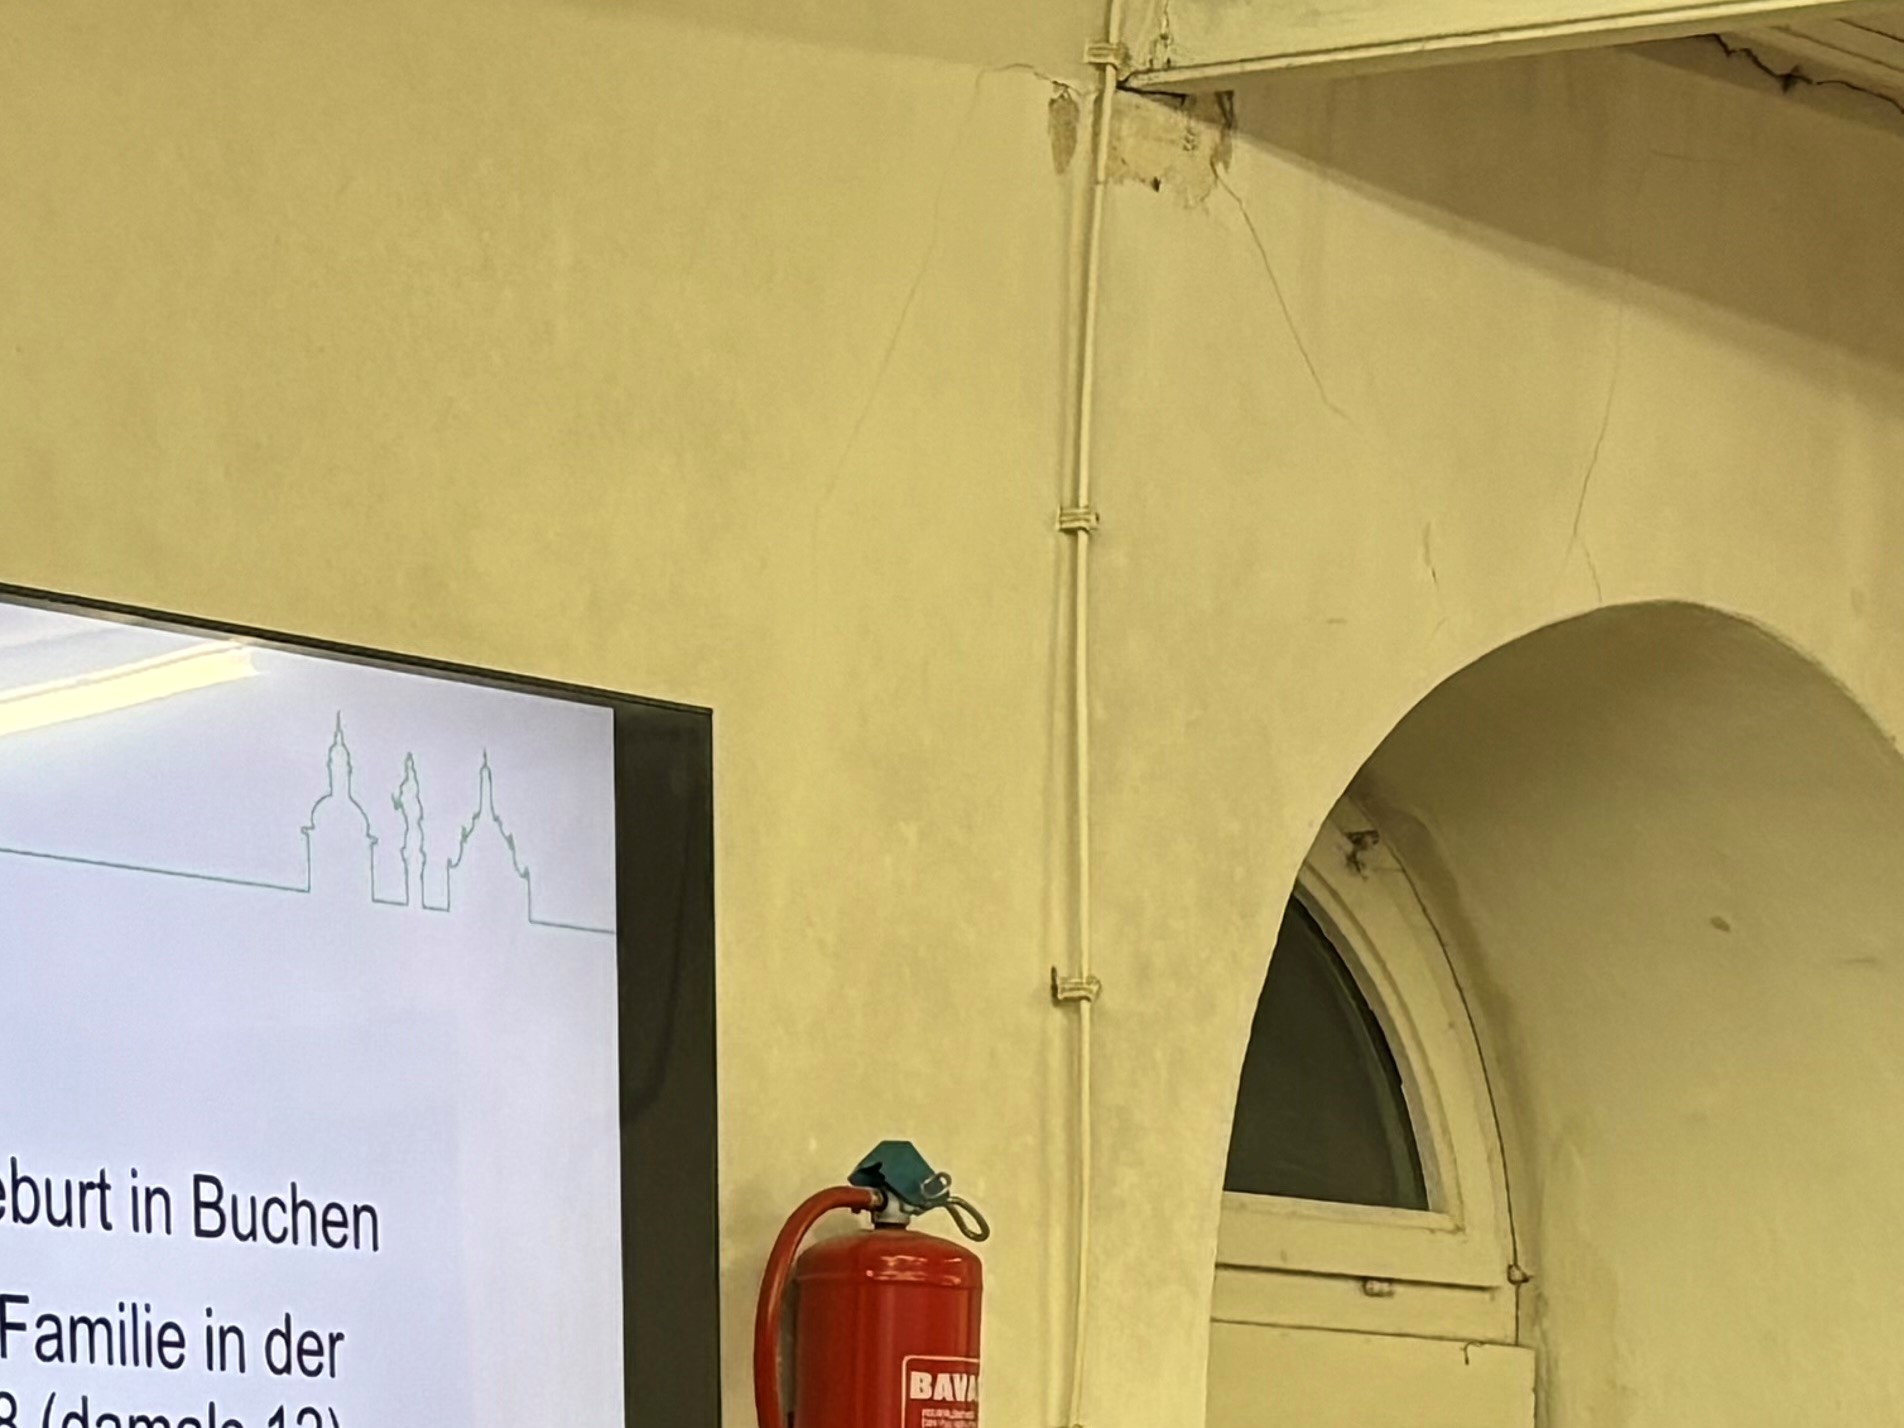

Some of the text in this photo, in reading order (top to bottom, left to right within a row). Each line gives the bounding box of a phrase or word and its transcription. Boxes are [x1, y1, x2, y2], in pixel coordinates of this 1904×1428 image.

[131, 1168, 171, 1235] in
[193, 1174, 378, 1252] Buchen
[0, 1294, 185, 1369] Familie
[206, 1307, 245, 1373] in
[265, 1313, 345, 1378] der
